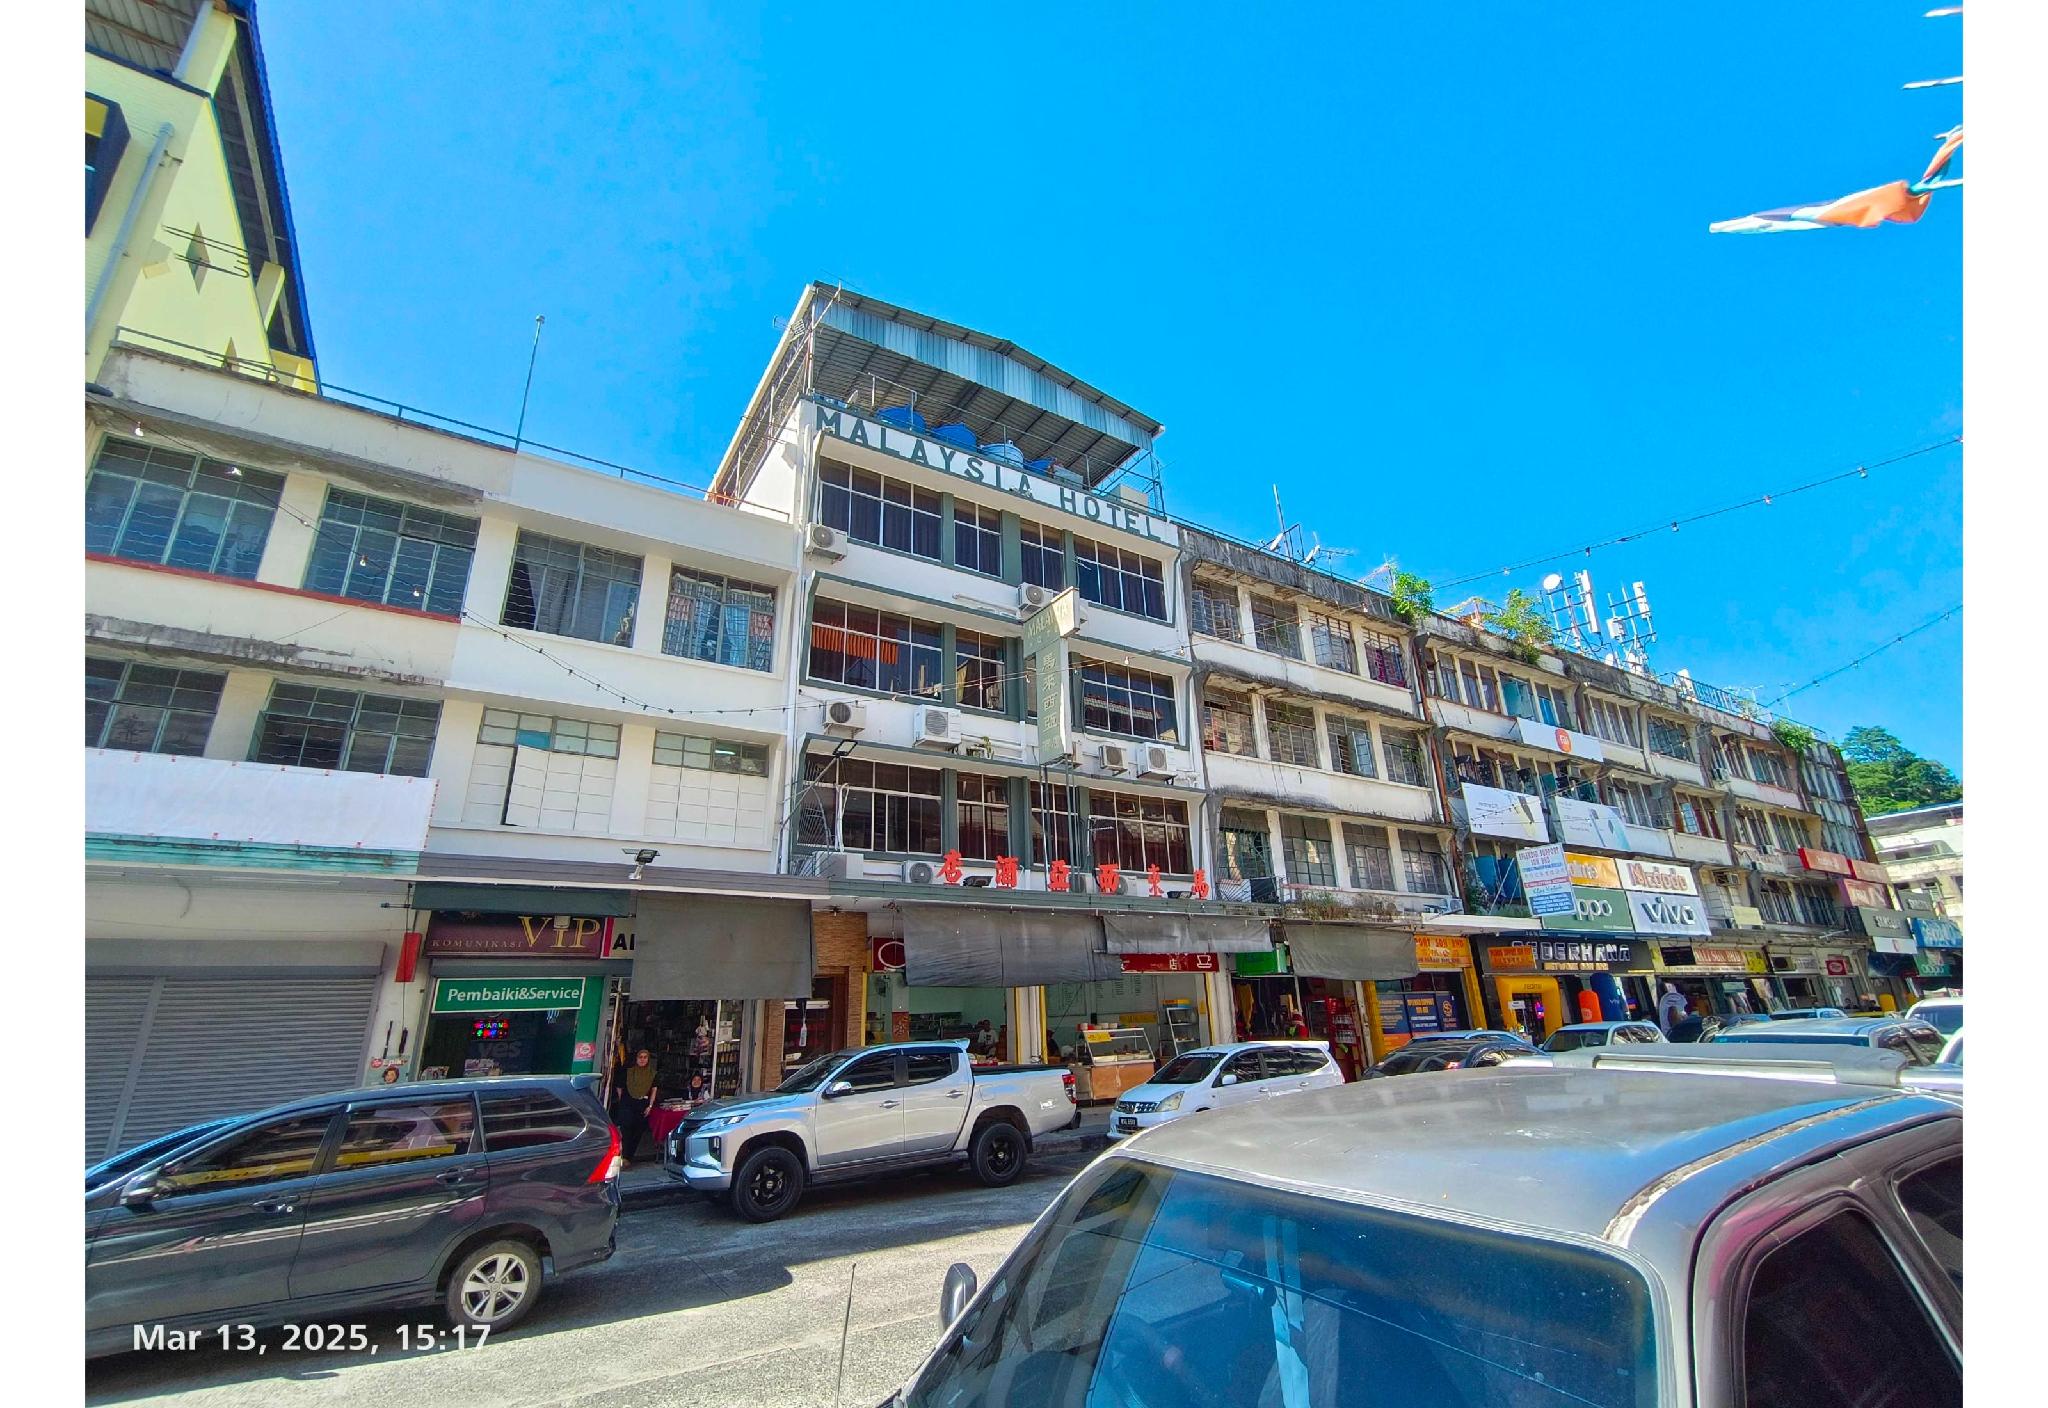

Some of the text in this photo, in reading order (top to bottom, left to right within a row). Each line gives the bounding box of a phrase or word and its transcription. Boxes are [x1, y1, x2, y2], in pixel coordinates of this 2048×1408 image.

[816, 406, 1161, 540] MALAYSIA HOTEL
[1576, 900, 1613, 921] ppo
[1641, 896, 1696, 925] vivo
[432, 939, 523, 949] KOMUNIKASI
[448, 987, 580, 1002] Pembaiki&Service
